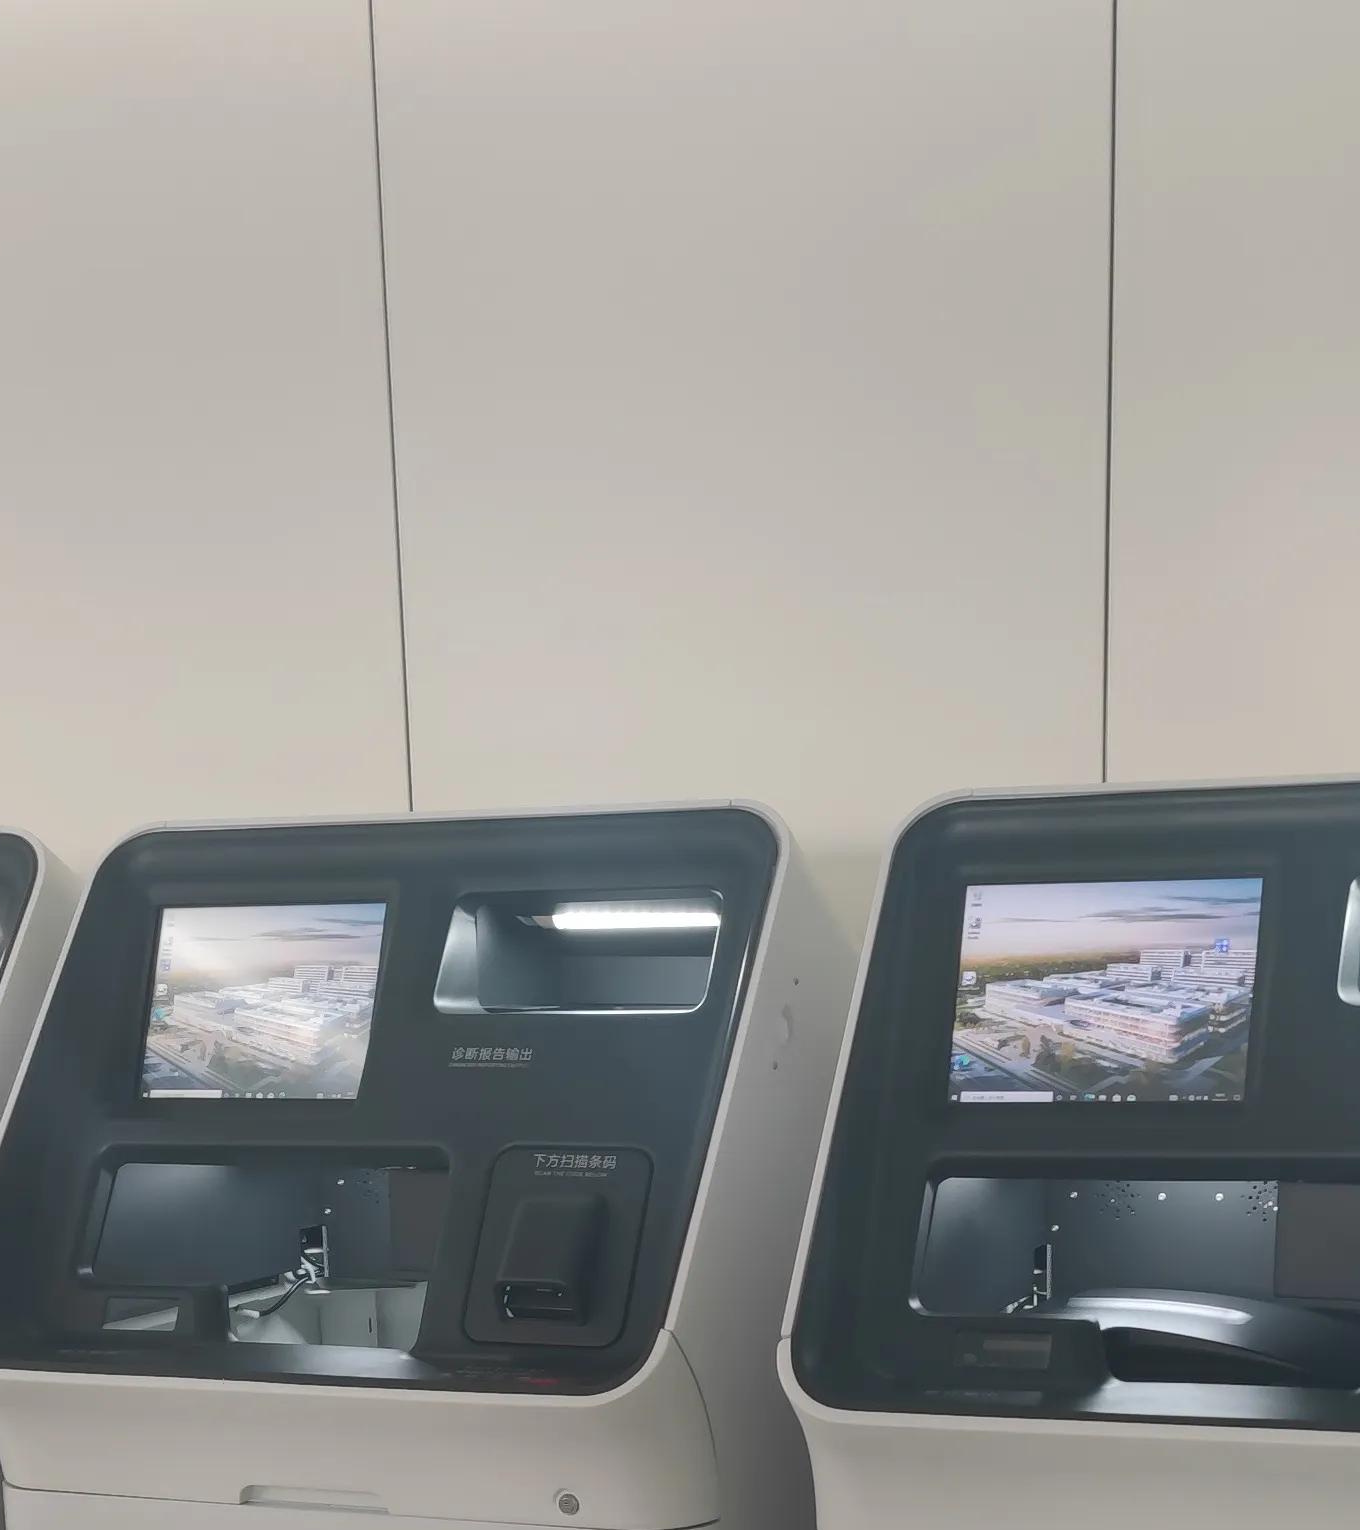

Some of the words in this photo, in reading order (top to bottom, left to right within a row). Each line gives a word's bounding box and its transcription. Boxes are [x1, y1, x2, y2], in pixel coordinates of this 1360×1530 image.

[451, 1047, 533, 1061] 诊断报告输出
[533, 1153, 617, 1169] 下方扫描条码
